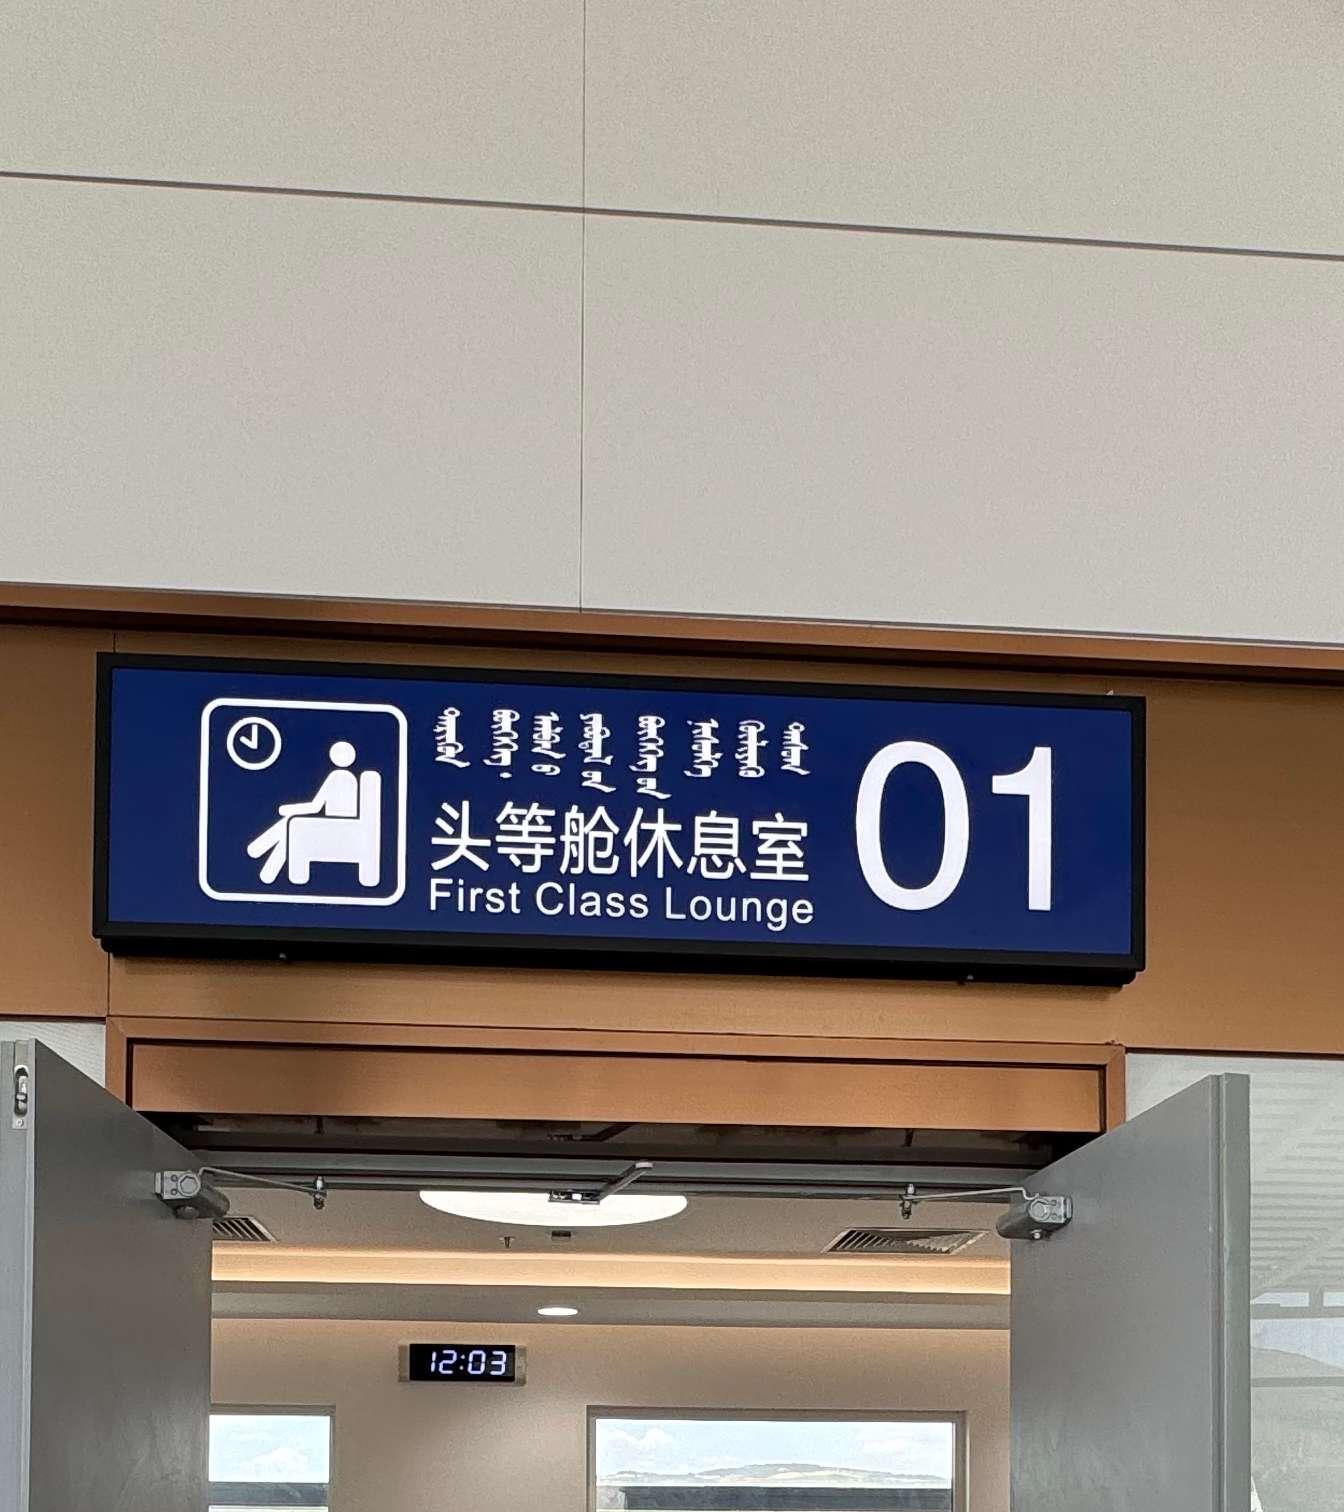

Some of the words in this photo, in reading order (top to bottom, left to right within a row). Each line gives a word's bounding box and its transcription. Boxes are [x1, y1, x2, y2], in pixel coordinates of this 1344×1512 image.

[430, 800, 810, 882] 头等舱休息室
[855, 740, 1052, 911] 01
[430, 878, 521, 914] First
[535, 881, 649, 919] Class
[665, 886, 814, 932] Lounge
[430, 1349, 507, 1376] 12:03
